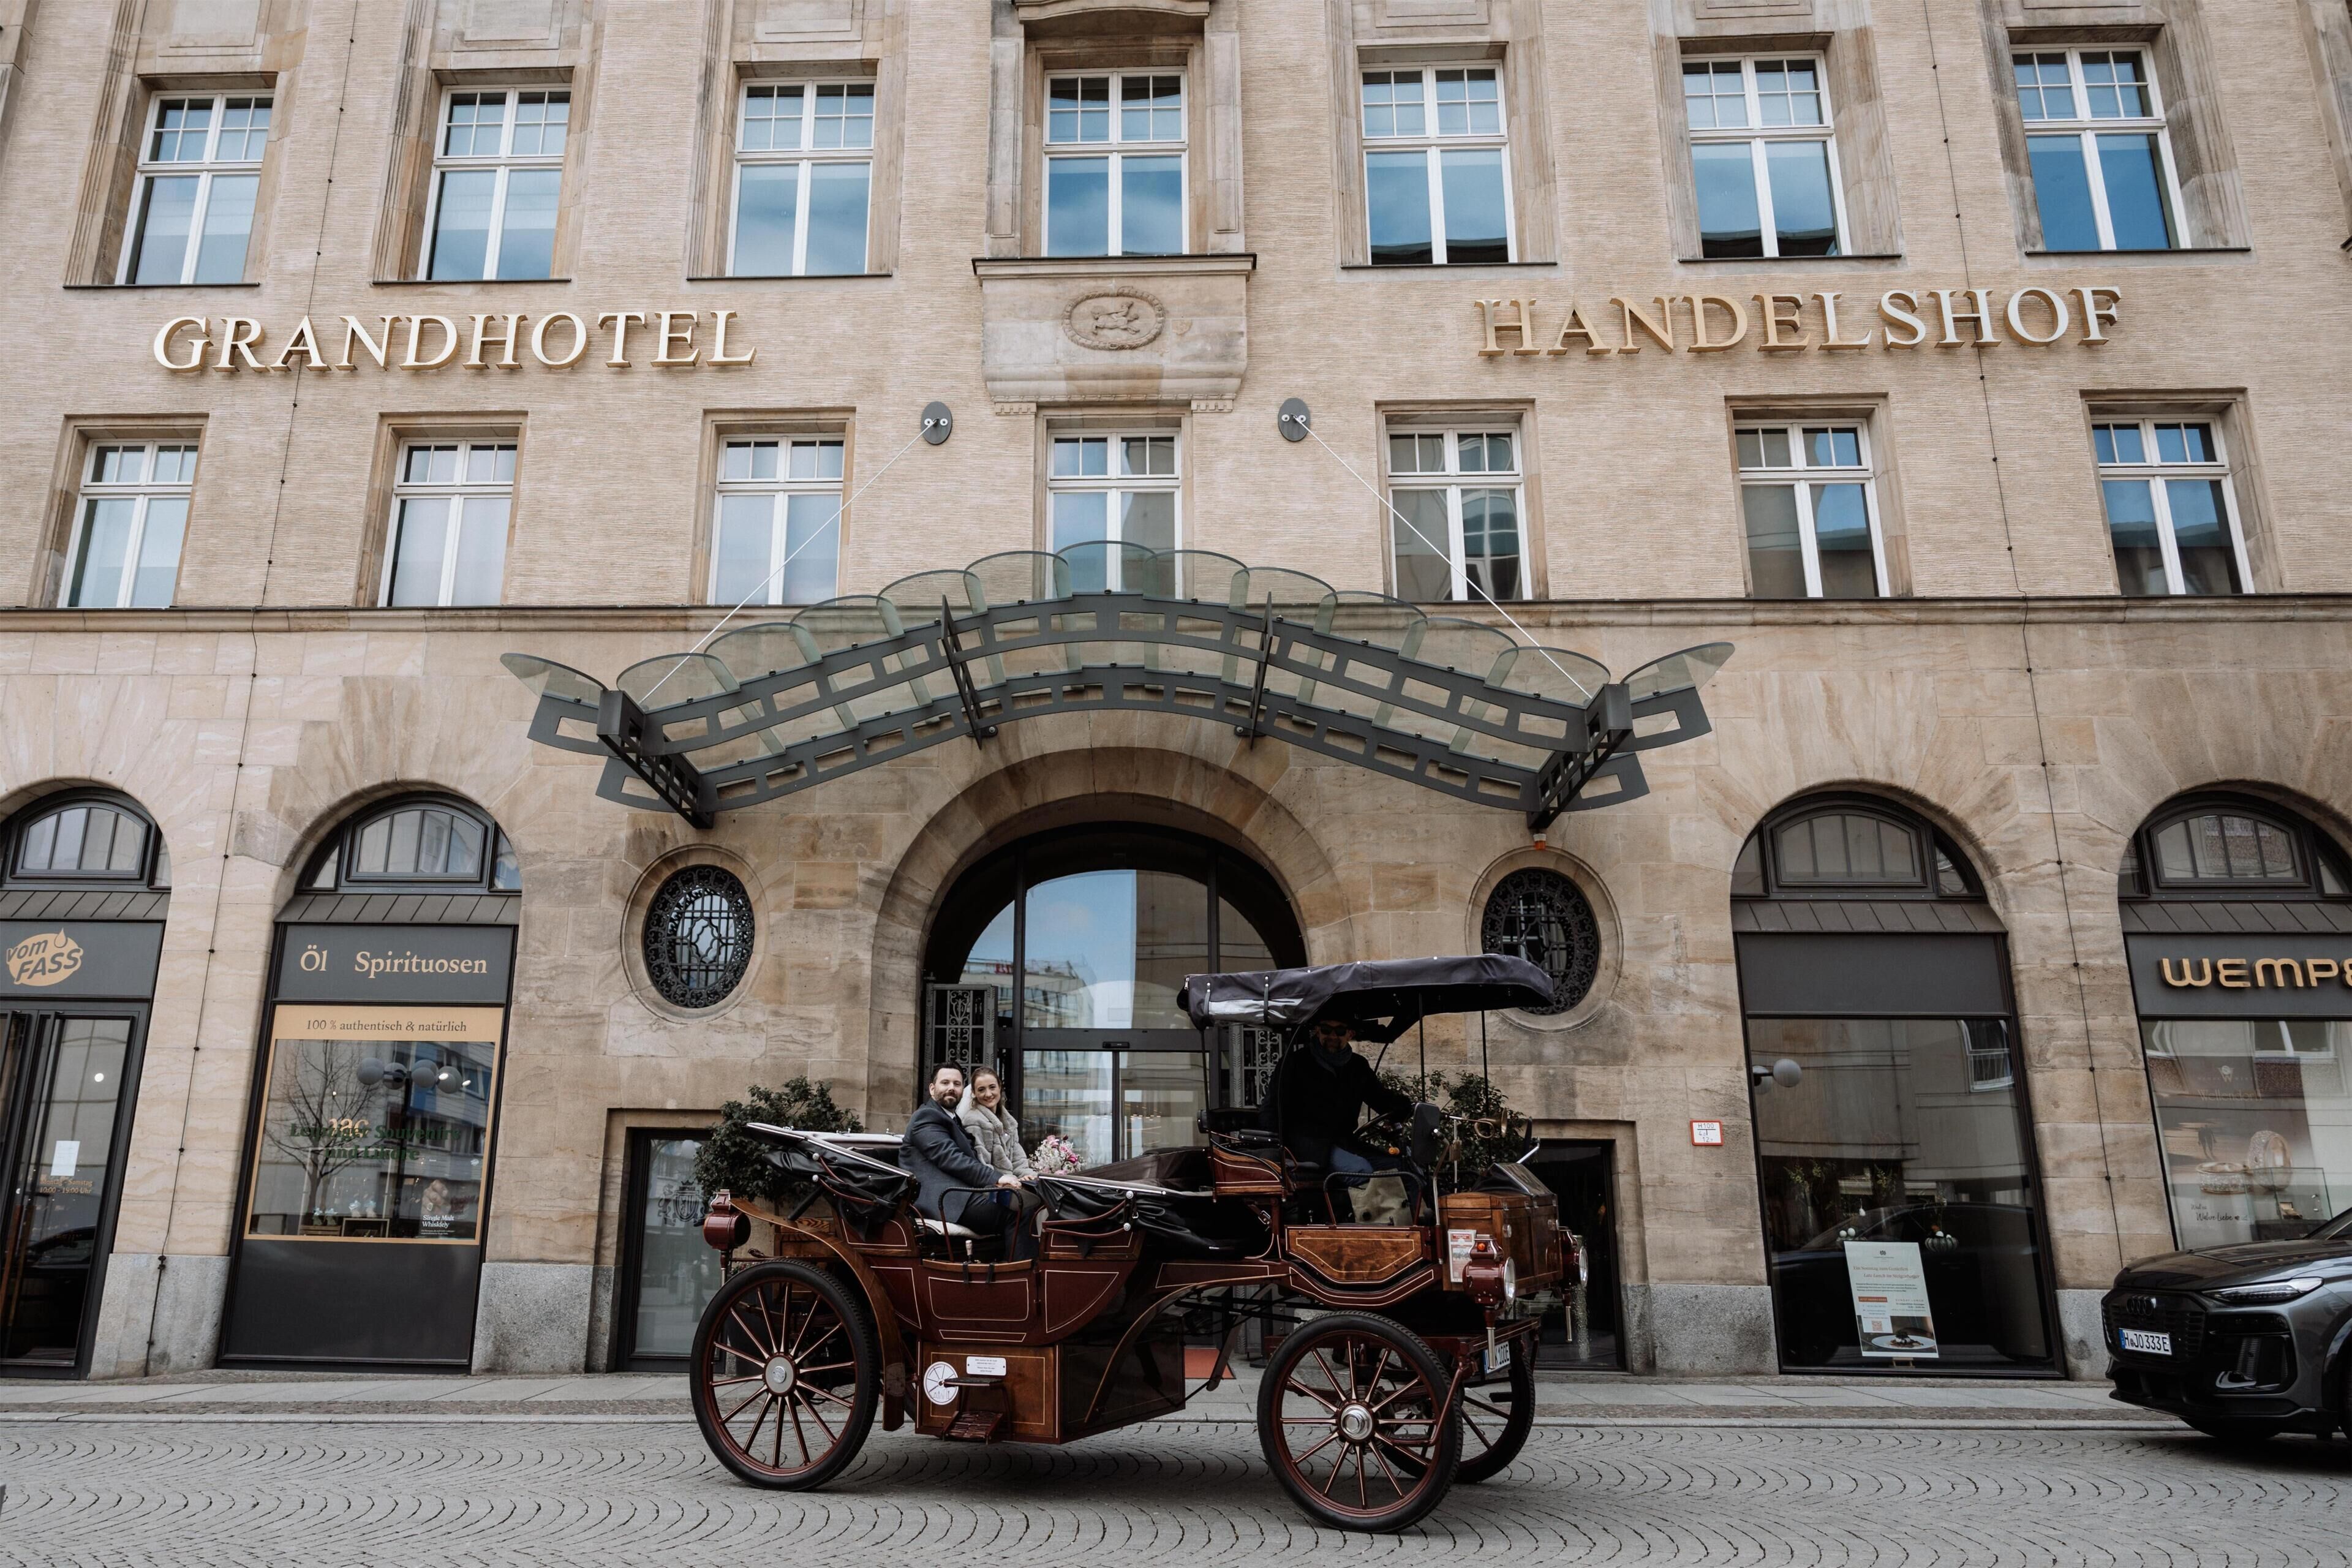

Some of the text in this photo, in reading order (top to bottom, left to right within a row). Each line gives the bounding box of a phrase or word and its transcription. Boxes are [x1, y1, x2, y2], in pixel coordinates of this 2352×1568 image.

[1474, 286, 2122, 356] HANDELSHOF
[153, 310, 756, 372] GRANDHOTEL
[7, 940, 48, 962] vom
[300, 944, 488, 978] Öl Spirituosen
[15, 948, 81, 982] FASS
[2160, 958, 2352, 987] WEMP
[307, 1020, 327, 1030] 100
[330, 1020, 337, 1029] %
[340, 1020, 402, 1031] authentisch
[418, 1021, 467, 1031] natürlich
[290, 1123, 372, 1142] Leipziger
[374, 1125, 461, 1140] Souvenirs
[325, 1145, 360, 1159] und
[2217, 1212, 2233, 1221] Liebe
